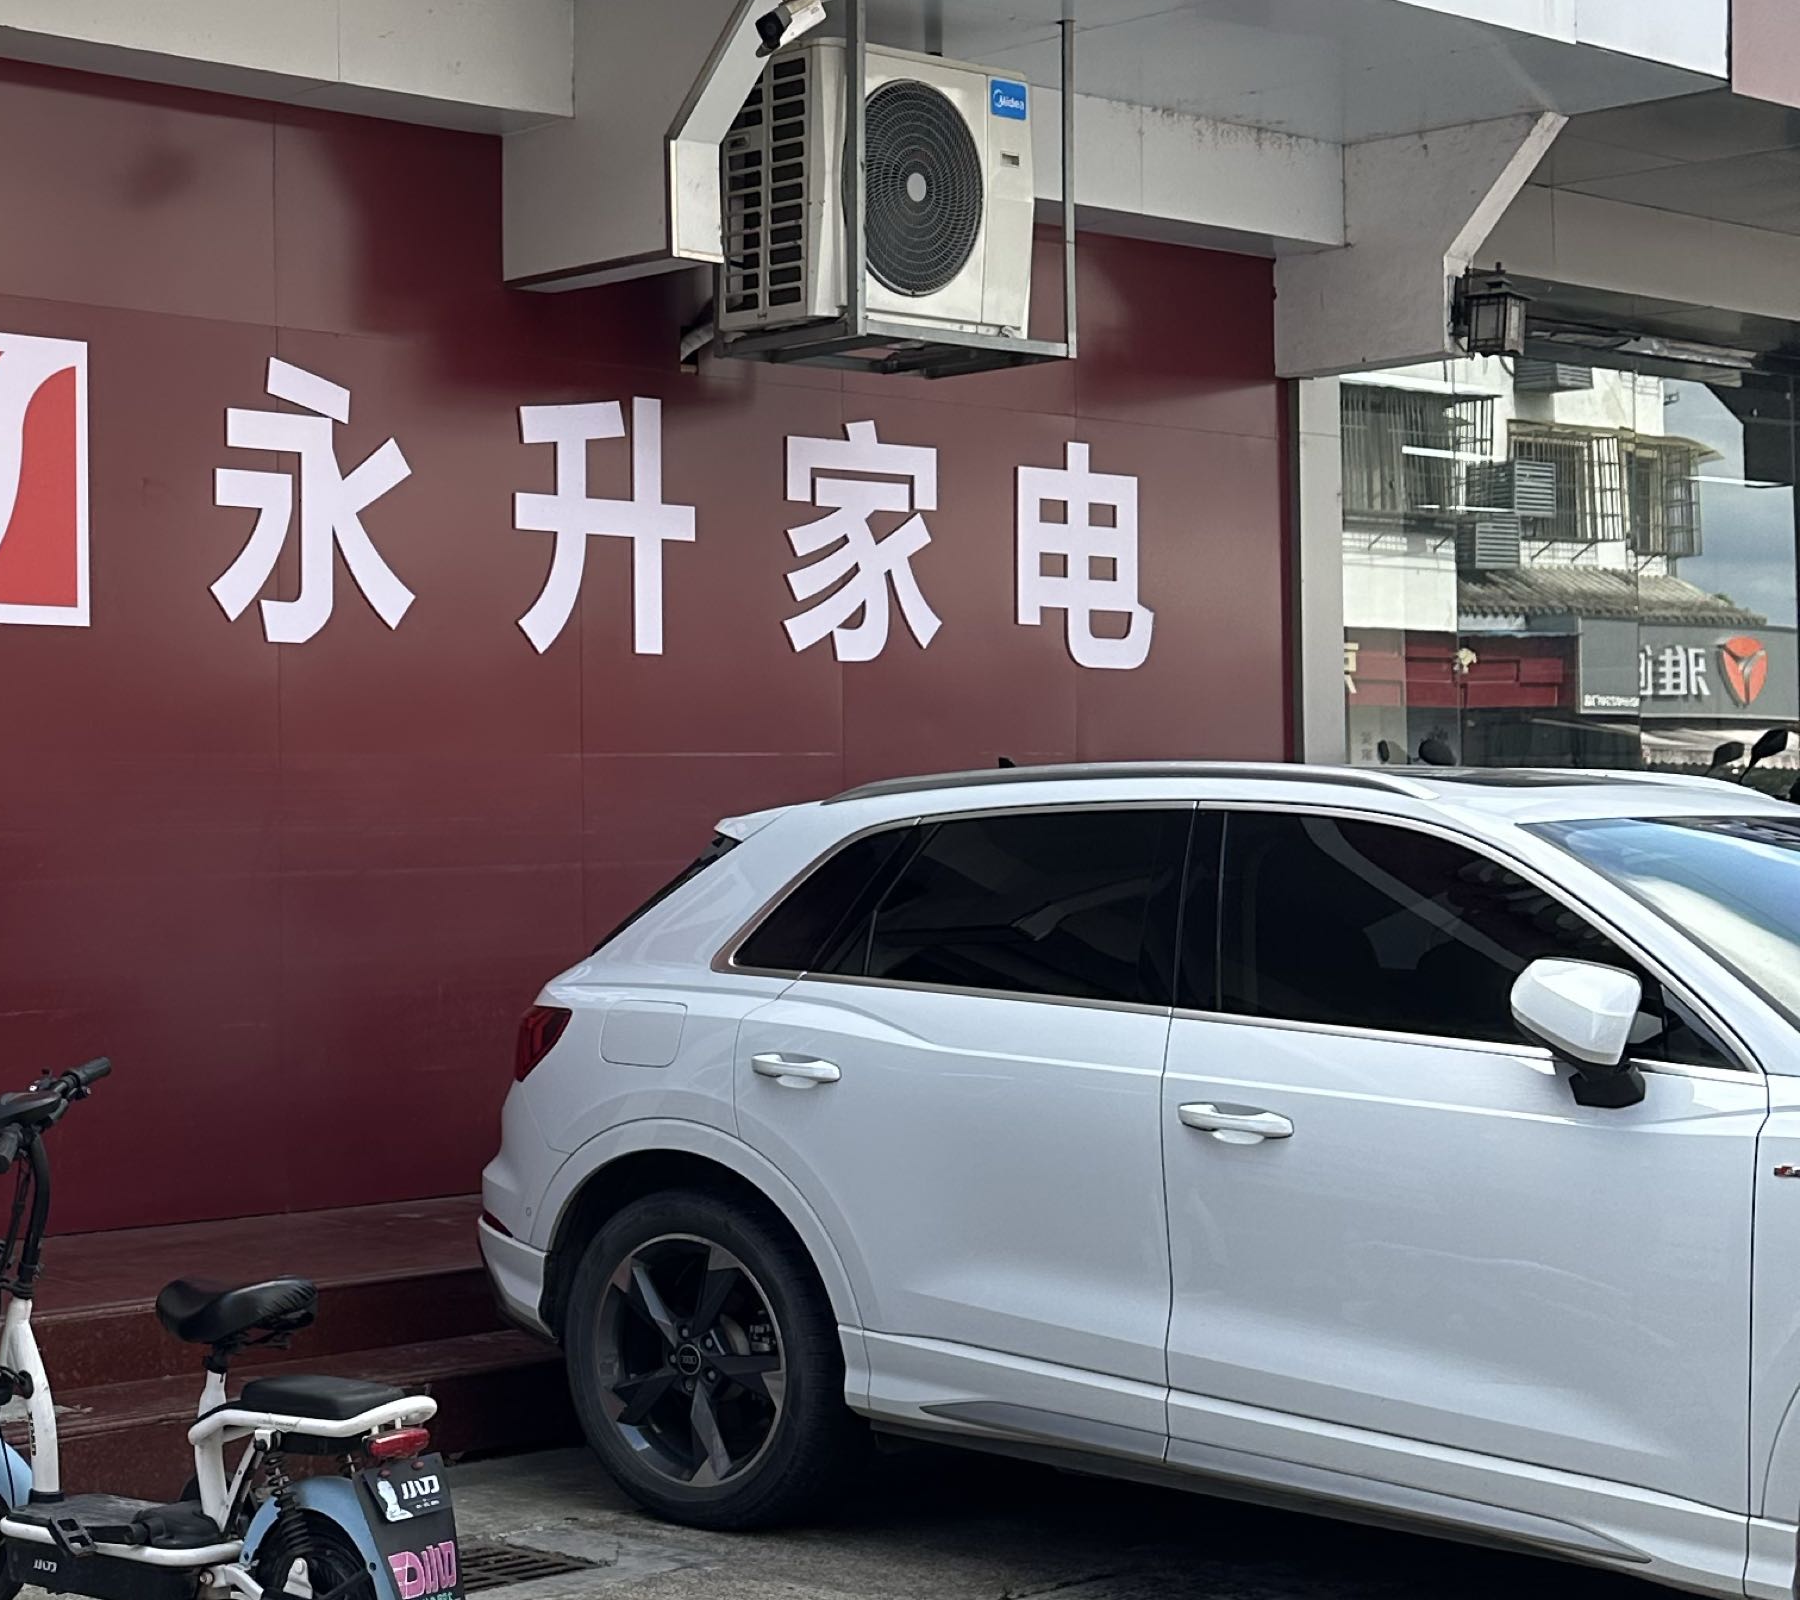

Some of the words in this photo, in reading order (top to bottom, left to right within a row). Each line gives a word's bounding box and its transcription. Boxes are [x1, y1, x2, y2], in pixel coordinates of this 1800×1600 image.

[995, 91, 1025, 111] Midea
[209, 357, 1155, 670] 永升家电
